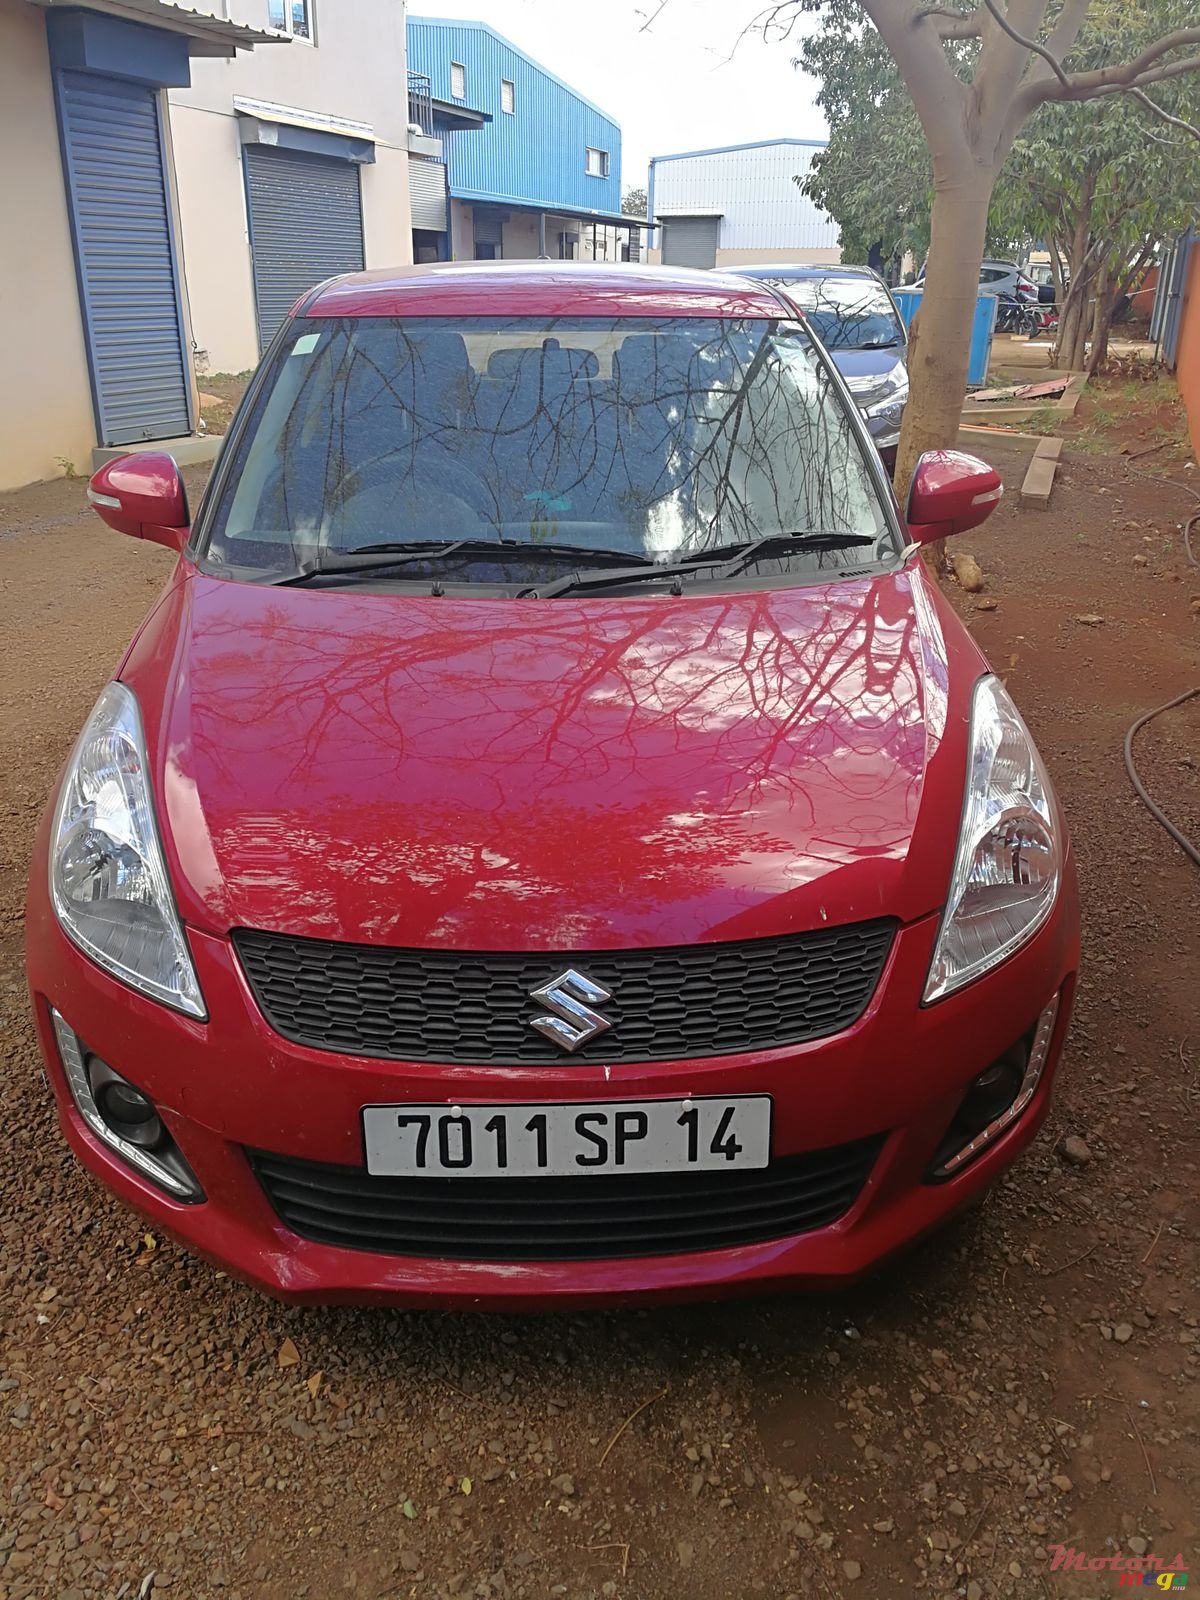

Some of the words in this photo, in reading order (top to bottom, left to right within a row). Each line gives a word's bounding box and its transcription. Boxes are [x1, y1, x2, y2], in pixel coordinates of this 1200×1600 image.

[398, 1113, 548, 1168] 7011
[575, 1111, 648, 1167] SP
[677, 1106, 742, 1162] 14
